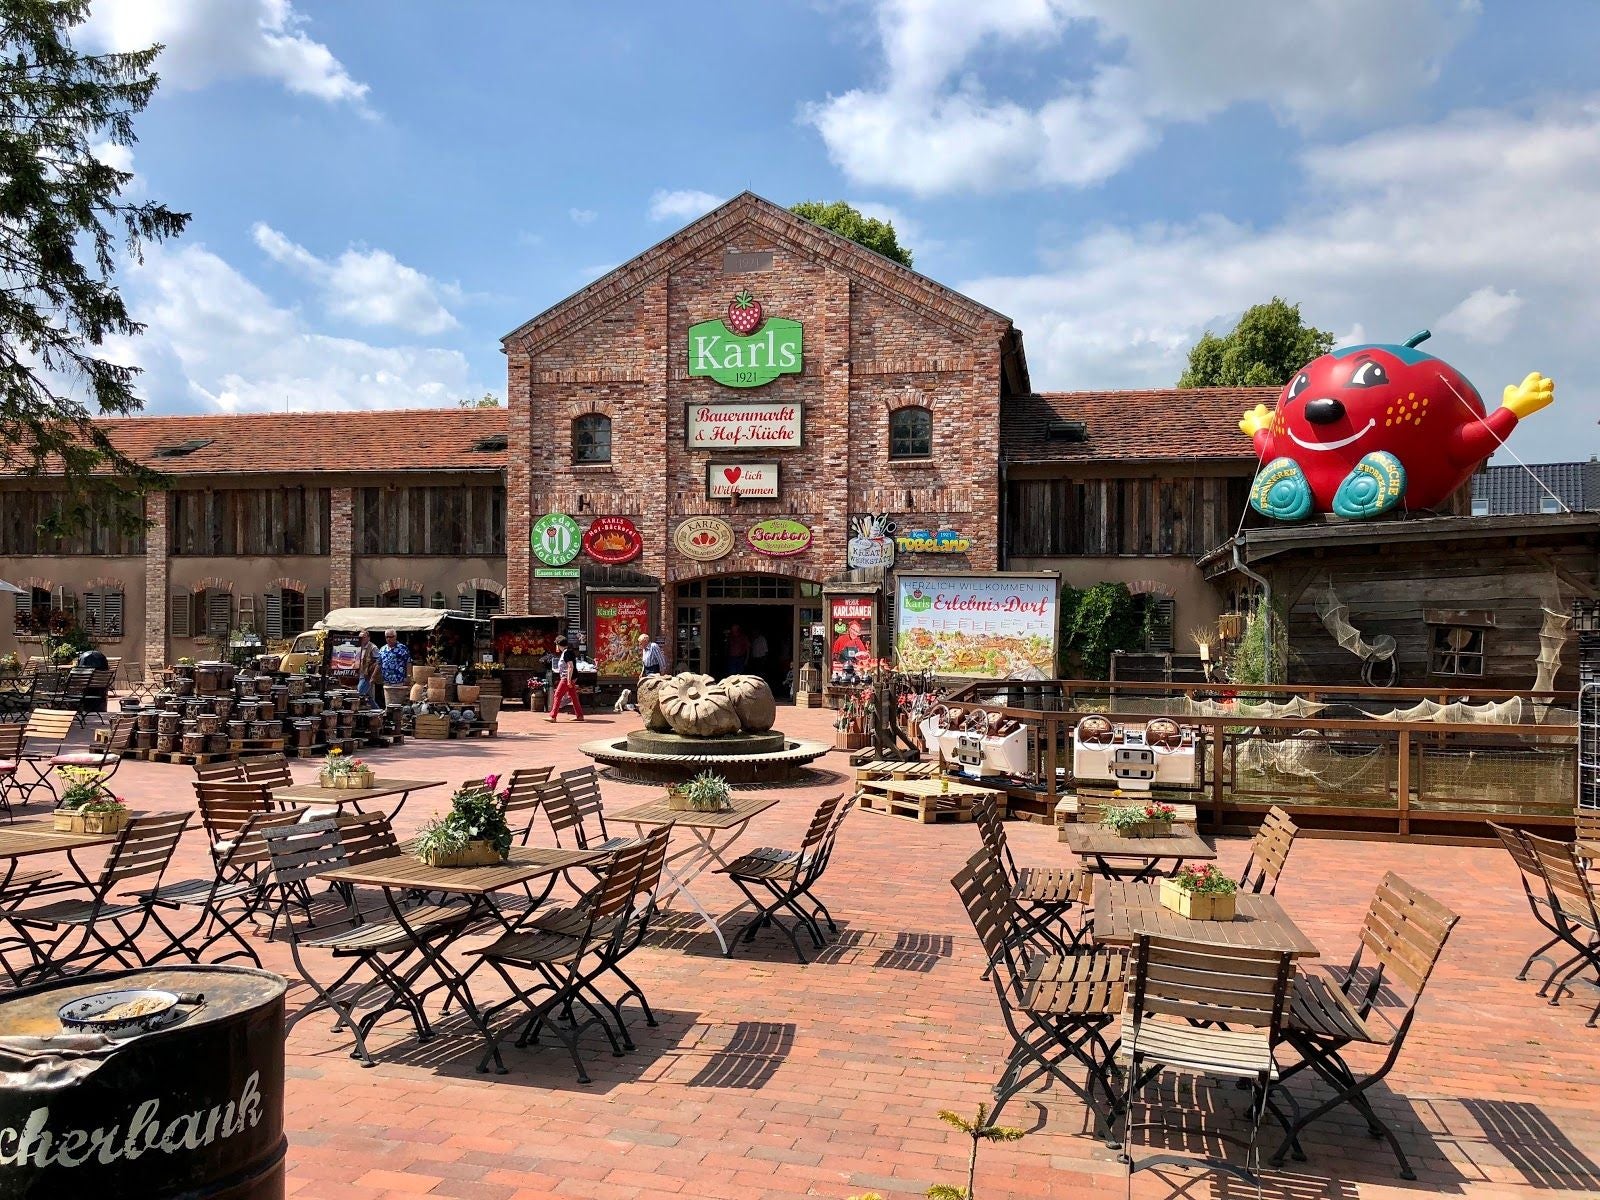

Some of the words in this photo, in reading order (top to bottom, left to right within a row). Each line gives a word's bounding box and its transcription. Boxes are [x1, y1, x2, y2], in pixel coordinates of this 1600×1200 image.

[695, 331, 796, 370] Karls
[736, 372, 757, 383] 1921
[695, 406, 795, 422] Bauernmarkt
[695, 430, 705, 441] &
[709, 425, 794, 445] Hof-Küche
[535, 516, 576, 534] Fredas
[688, 520, 721, 532] KARLS
[751, 527, 809, 541] Bonbon
[533, 541, 580, 565] Hof-Küche
[904, 581, 955, 590] HERZLICH
[960, 582, 1034, 592] WILLKOMMEN
[1038, 583, 1049, 592] IN
[597, 608, 617, 616] Karls
[833, 605, 872, 617] KARLSIANER
[905, 598, 931, 608] Karls
[933, 594, 1049, 616] Erlebnis-Dorf
